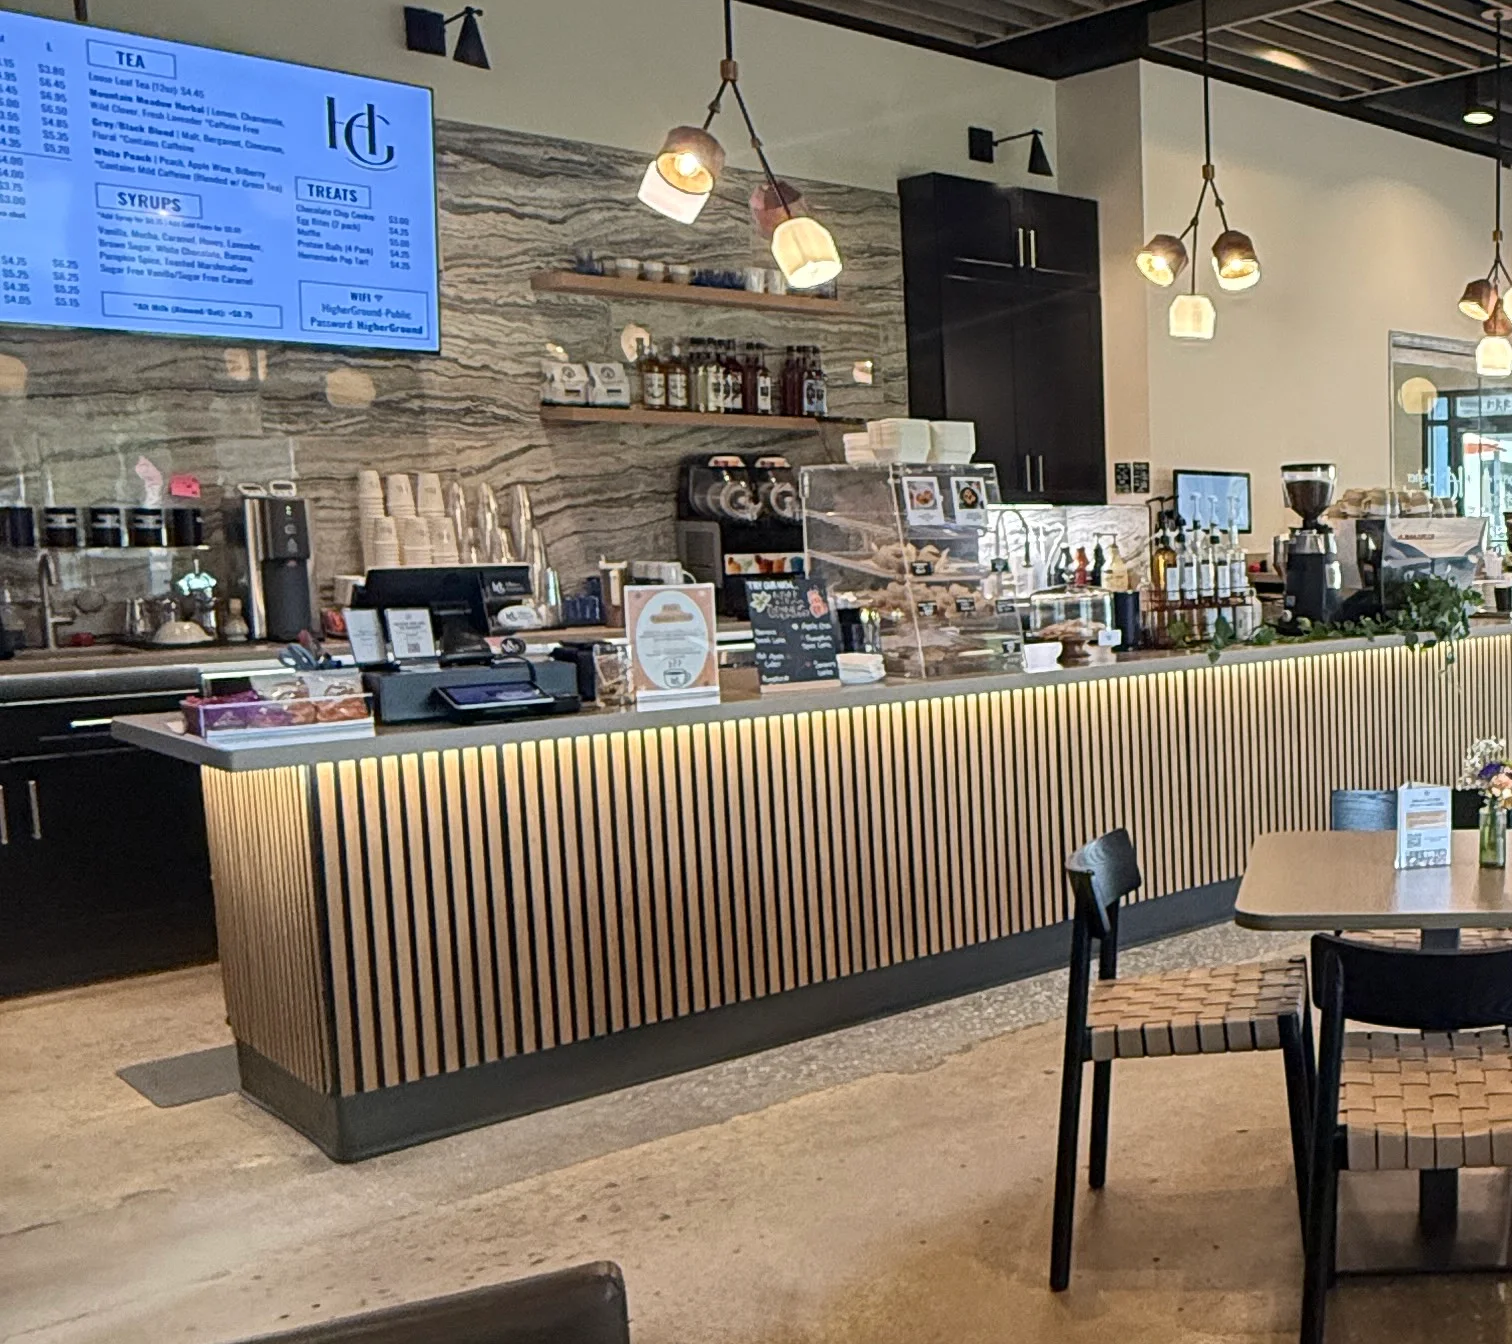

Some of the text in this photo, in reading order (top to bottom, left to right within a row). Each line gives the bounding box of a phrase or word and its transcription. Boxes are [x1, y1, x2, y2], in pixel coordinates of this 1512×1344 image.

[116, 51, 145, 69] TEA
[117, 192, 182, 212] SYRUPS
[307, 183, 358, 203] TREATS
[356, 320, 423, 334] HigherGround
